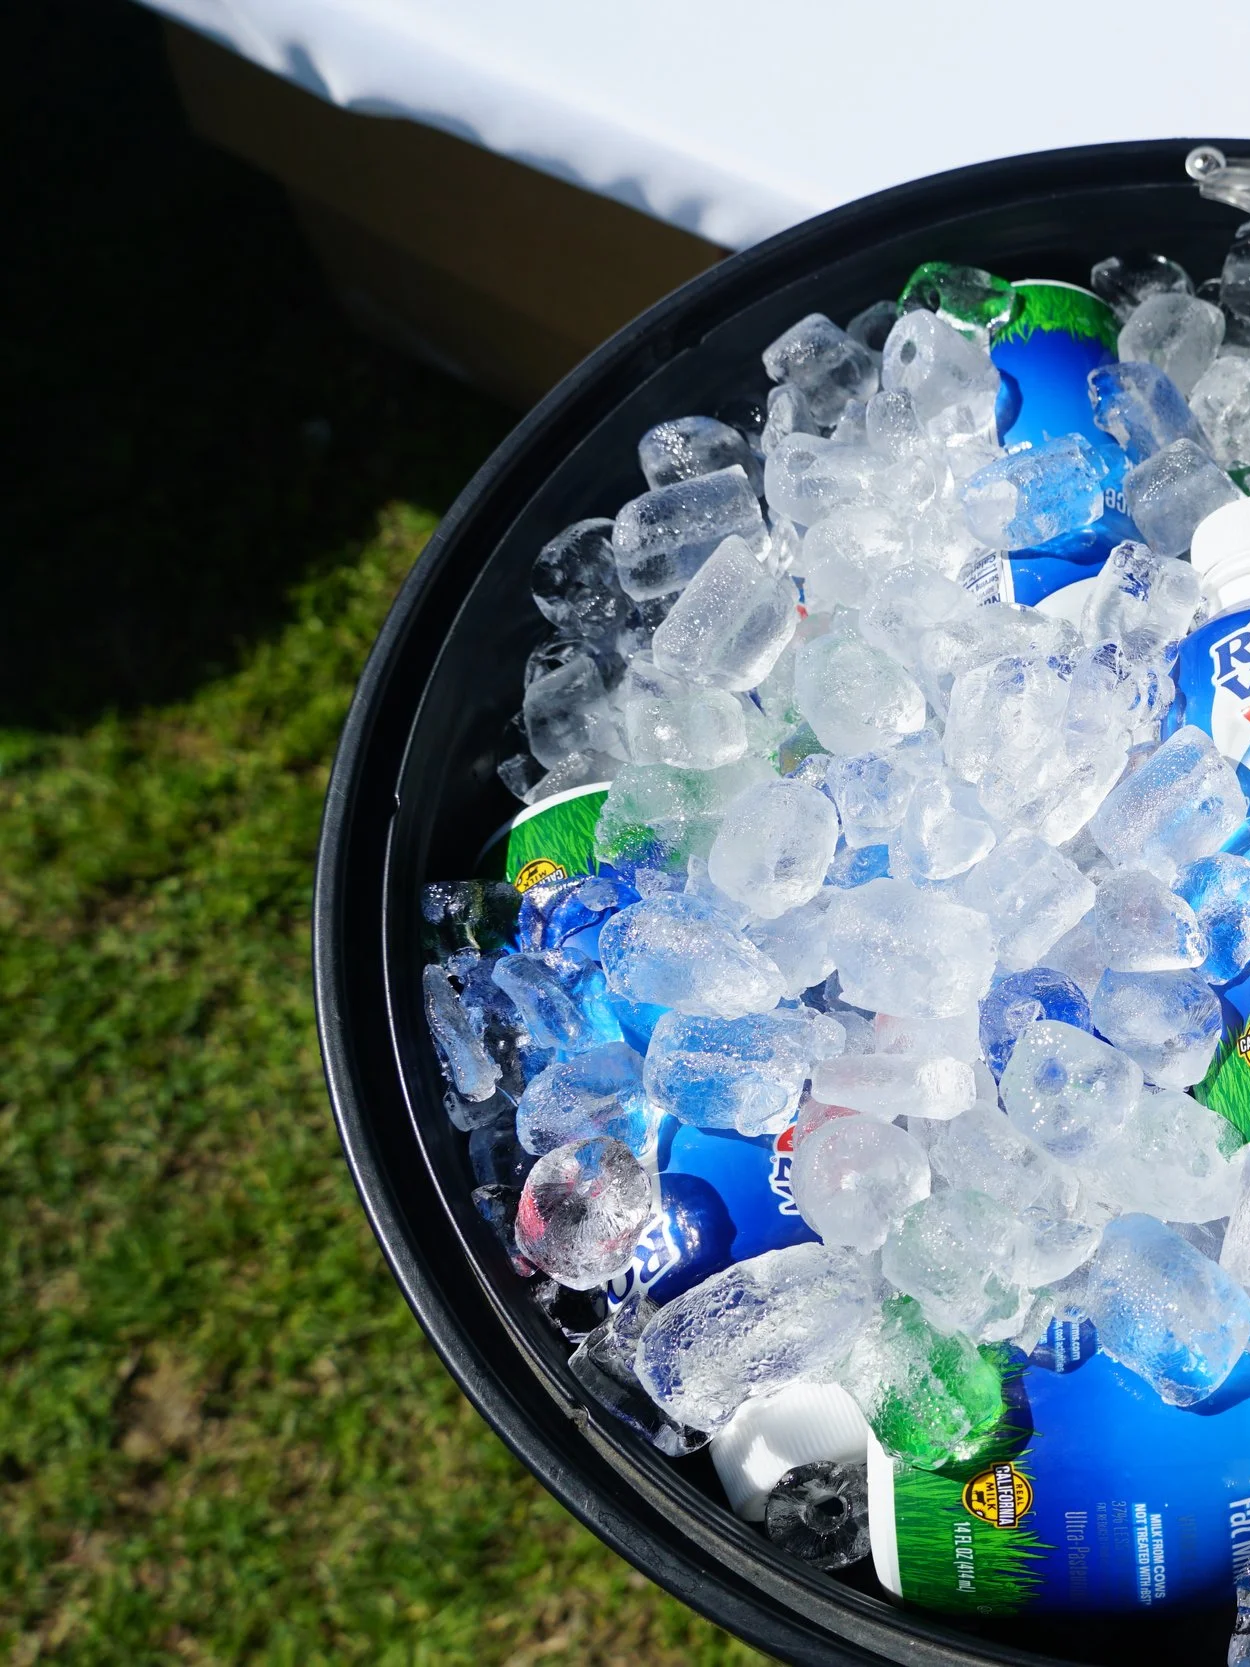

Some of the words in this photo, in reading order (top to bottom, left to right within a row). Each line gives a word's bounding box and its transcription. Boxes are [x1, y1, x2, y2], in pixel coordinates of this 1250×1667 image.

[985, 1482, 997, 1511] MILK
[995, 1465, 1015, 1526] CALIFORNIA
[1015, 1483, 1025, 1507] REAL
[1134, 1503, 1147, 1525] NOT
[1150, 1513, 1163, 1538] MILK
[953, 1521, 972, 1534] 14
[954, 1534, 973, 1546] FL
[1136, 1527, 1150, 1565] TREATED
[1152, 1538, 1164, 1564] FROM
[955, 1547, 974, 1561] OZ
[1139, 1565, 1151, 1586] WITH
[1153, 1565, 1166, 1599] COWS
